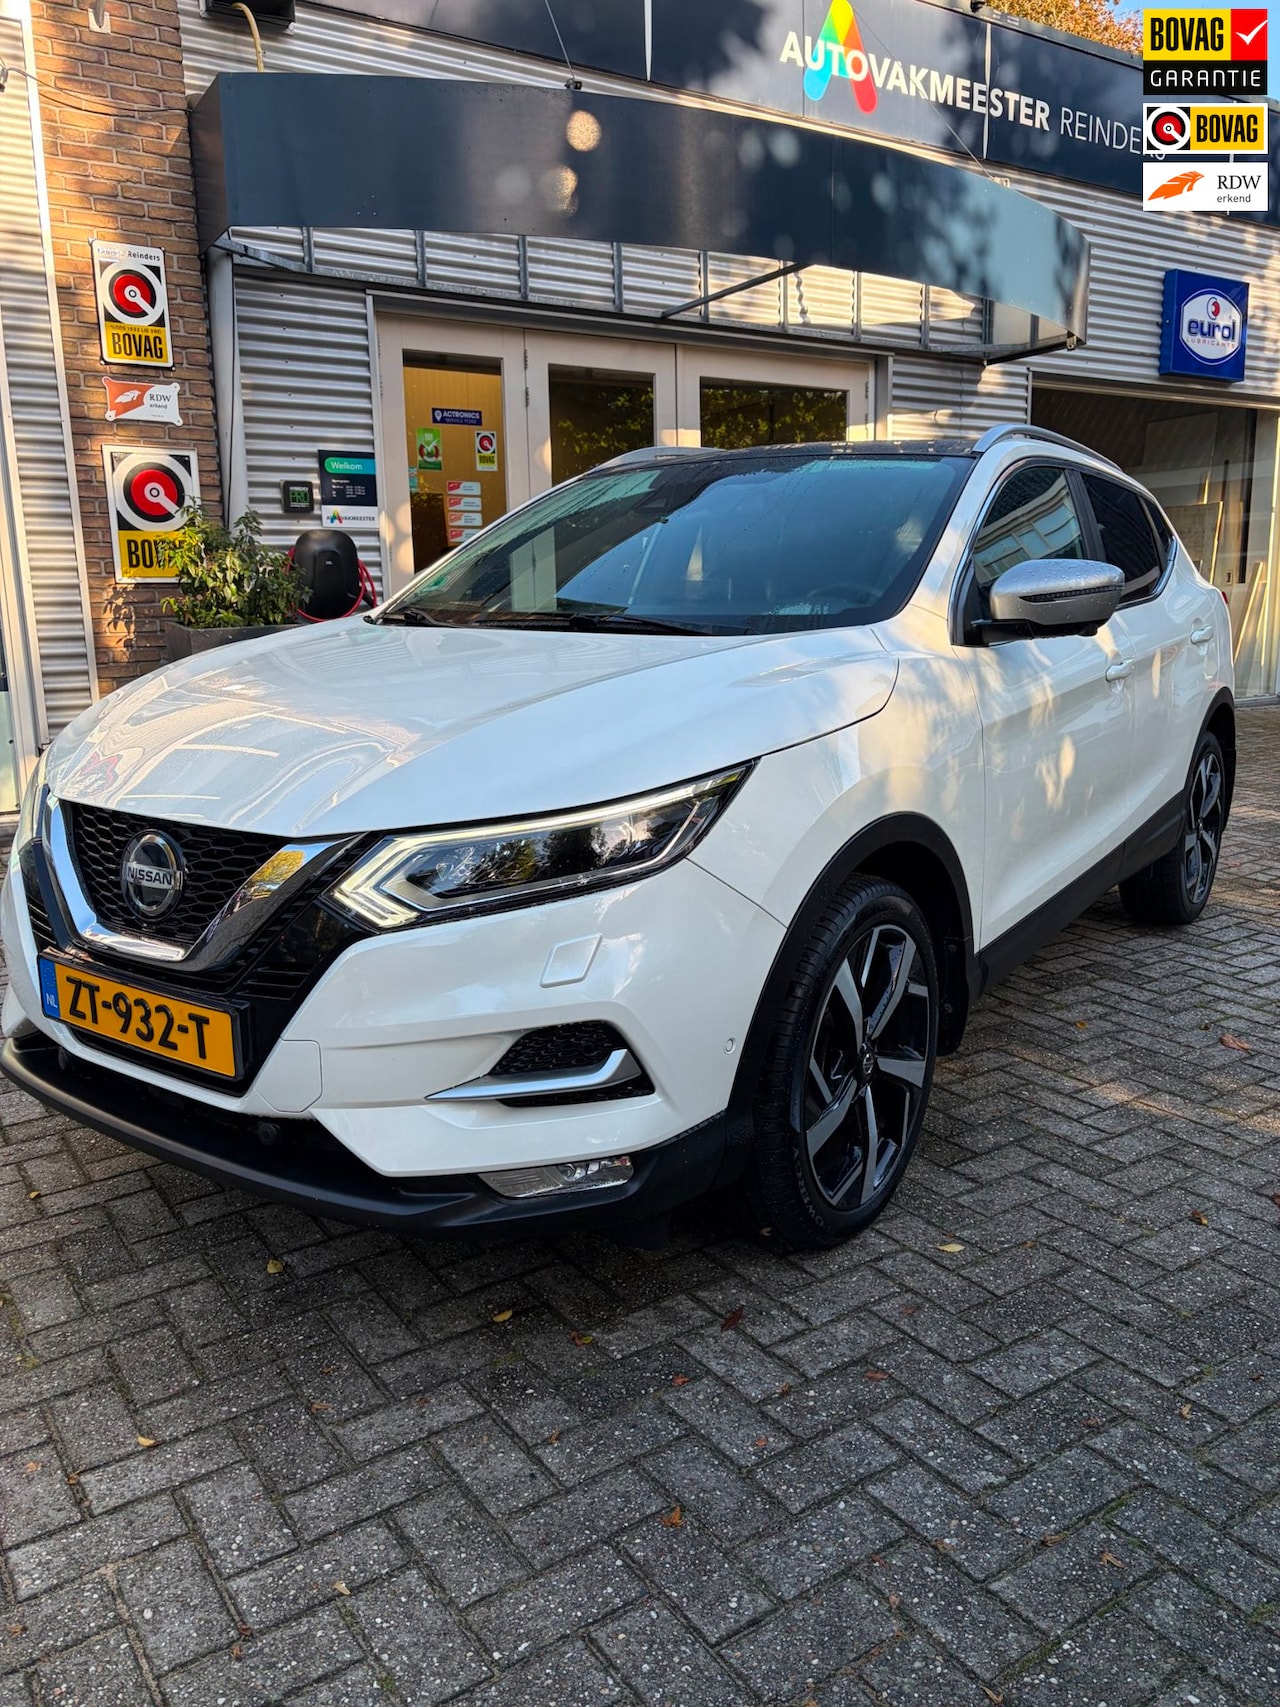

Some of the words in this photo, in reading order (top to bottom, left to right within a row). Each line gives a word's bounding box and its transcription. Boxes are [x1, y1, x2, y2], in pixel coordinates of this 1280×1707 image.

[779, 31, 1050, 131] AUTOVAKMEESTER
[1060, 107, 1166, 161] REINDE
[127, 250, 161, 262] Reinders
[1187, 319, 1236, 342] eurol
[111, 332, 163, 359] BOVAG
[1186, 338, 1236, 349] LUBRICANTS
[149, 393, 172, 402] RDW
[442, 410, 480, 420] ACTRONICS
[330, 461, 363, 471] Welkom
[127, 866, 173, 886] NISSAN
[46, 992, 58, 1009] NL
[66, 976, 210, 1060] ZT-932-T
